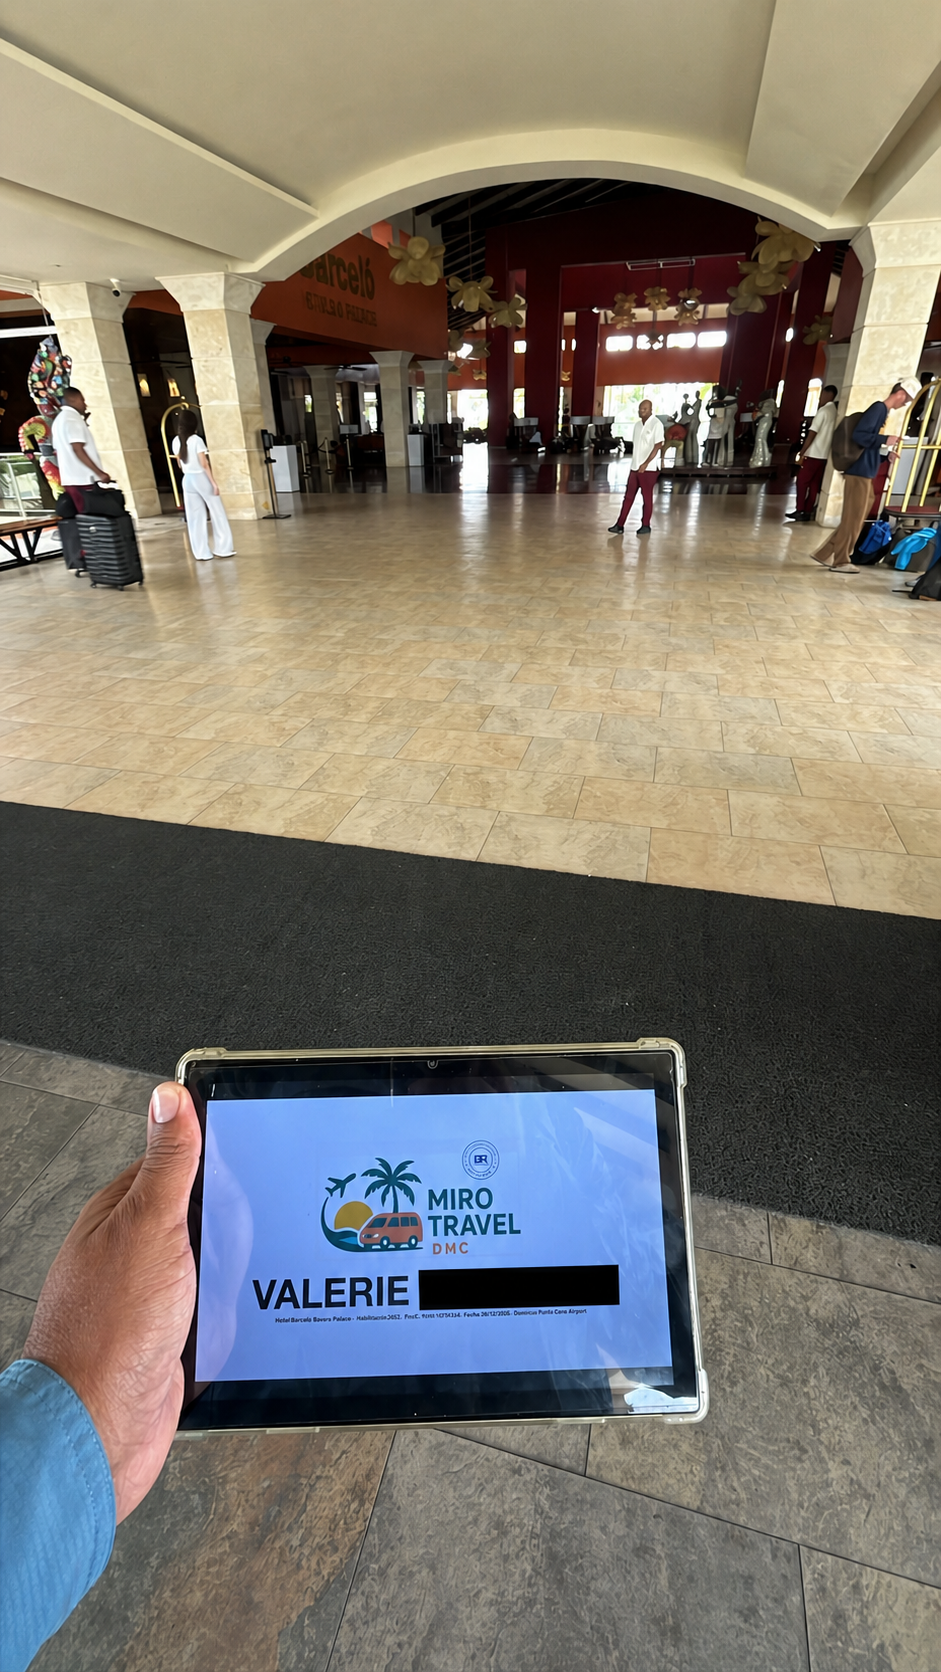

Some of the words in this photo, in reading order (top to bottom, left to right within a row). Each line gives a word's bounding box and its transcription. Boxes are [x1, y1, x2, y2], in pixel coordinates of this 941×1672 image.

[428, 1187, 493, 1211] MIRO
[427, 1213, 521, 1237] TRAVEL
[432, 1242, 469, 1255] DMC
[252, 1275, 409, 1310] VALERIE
